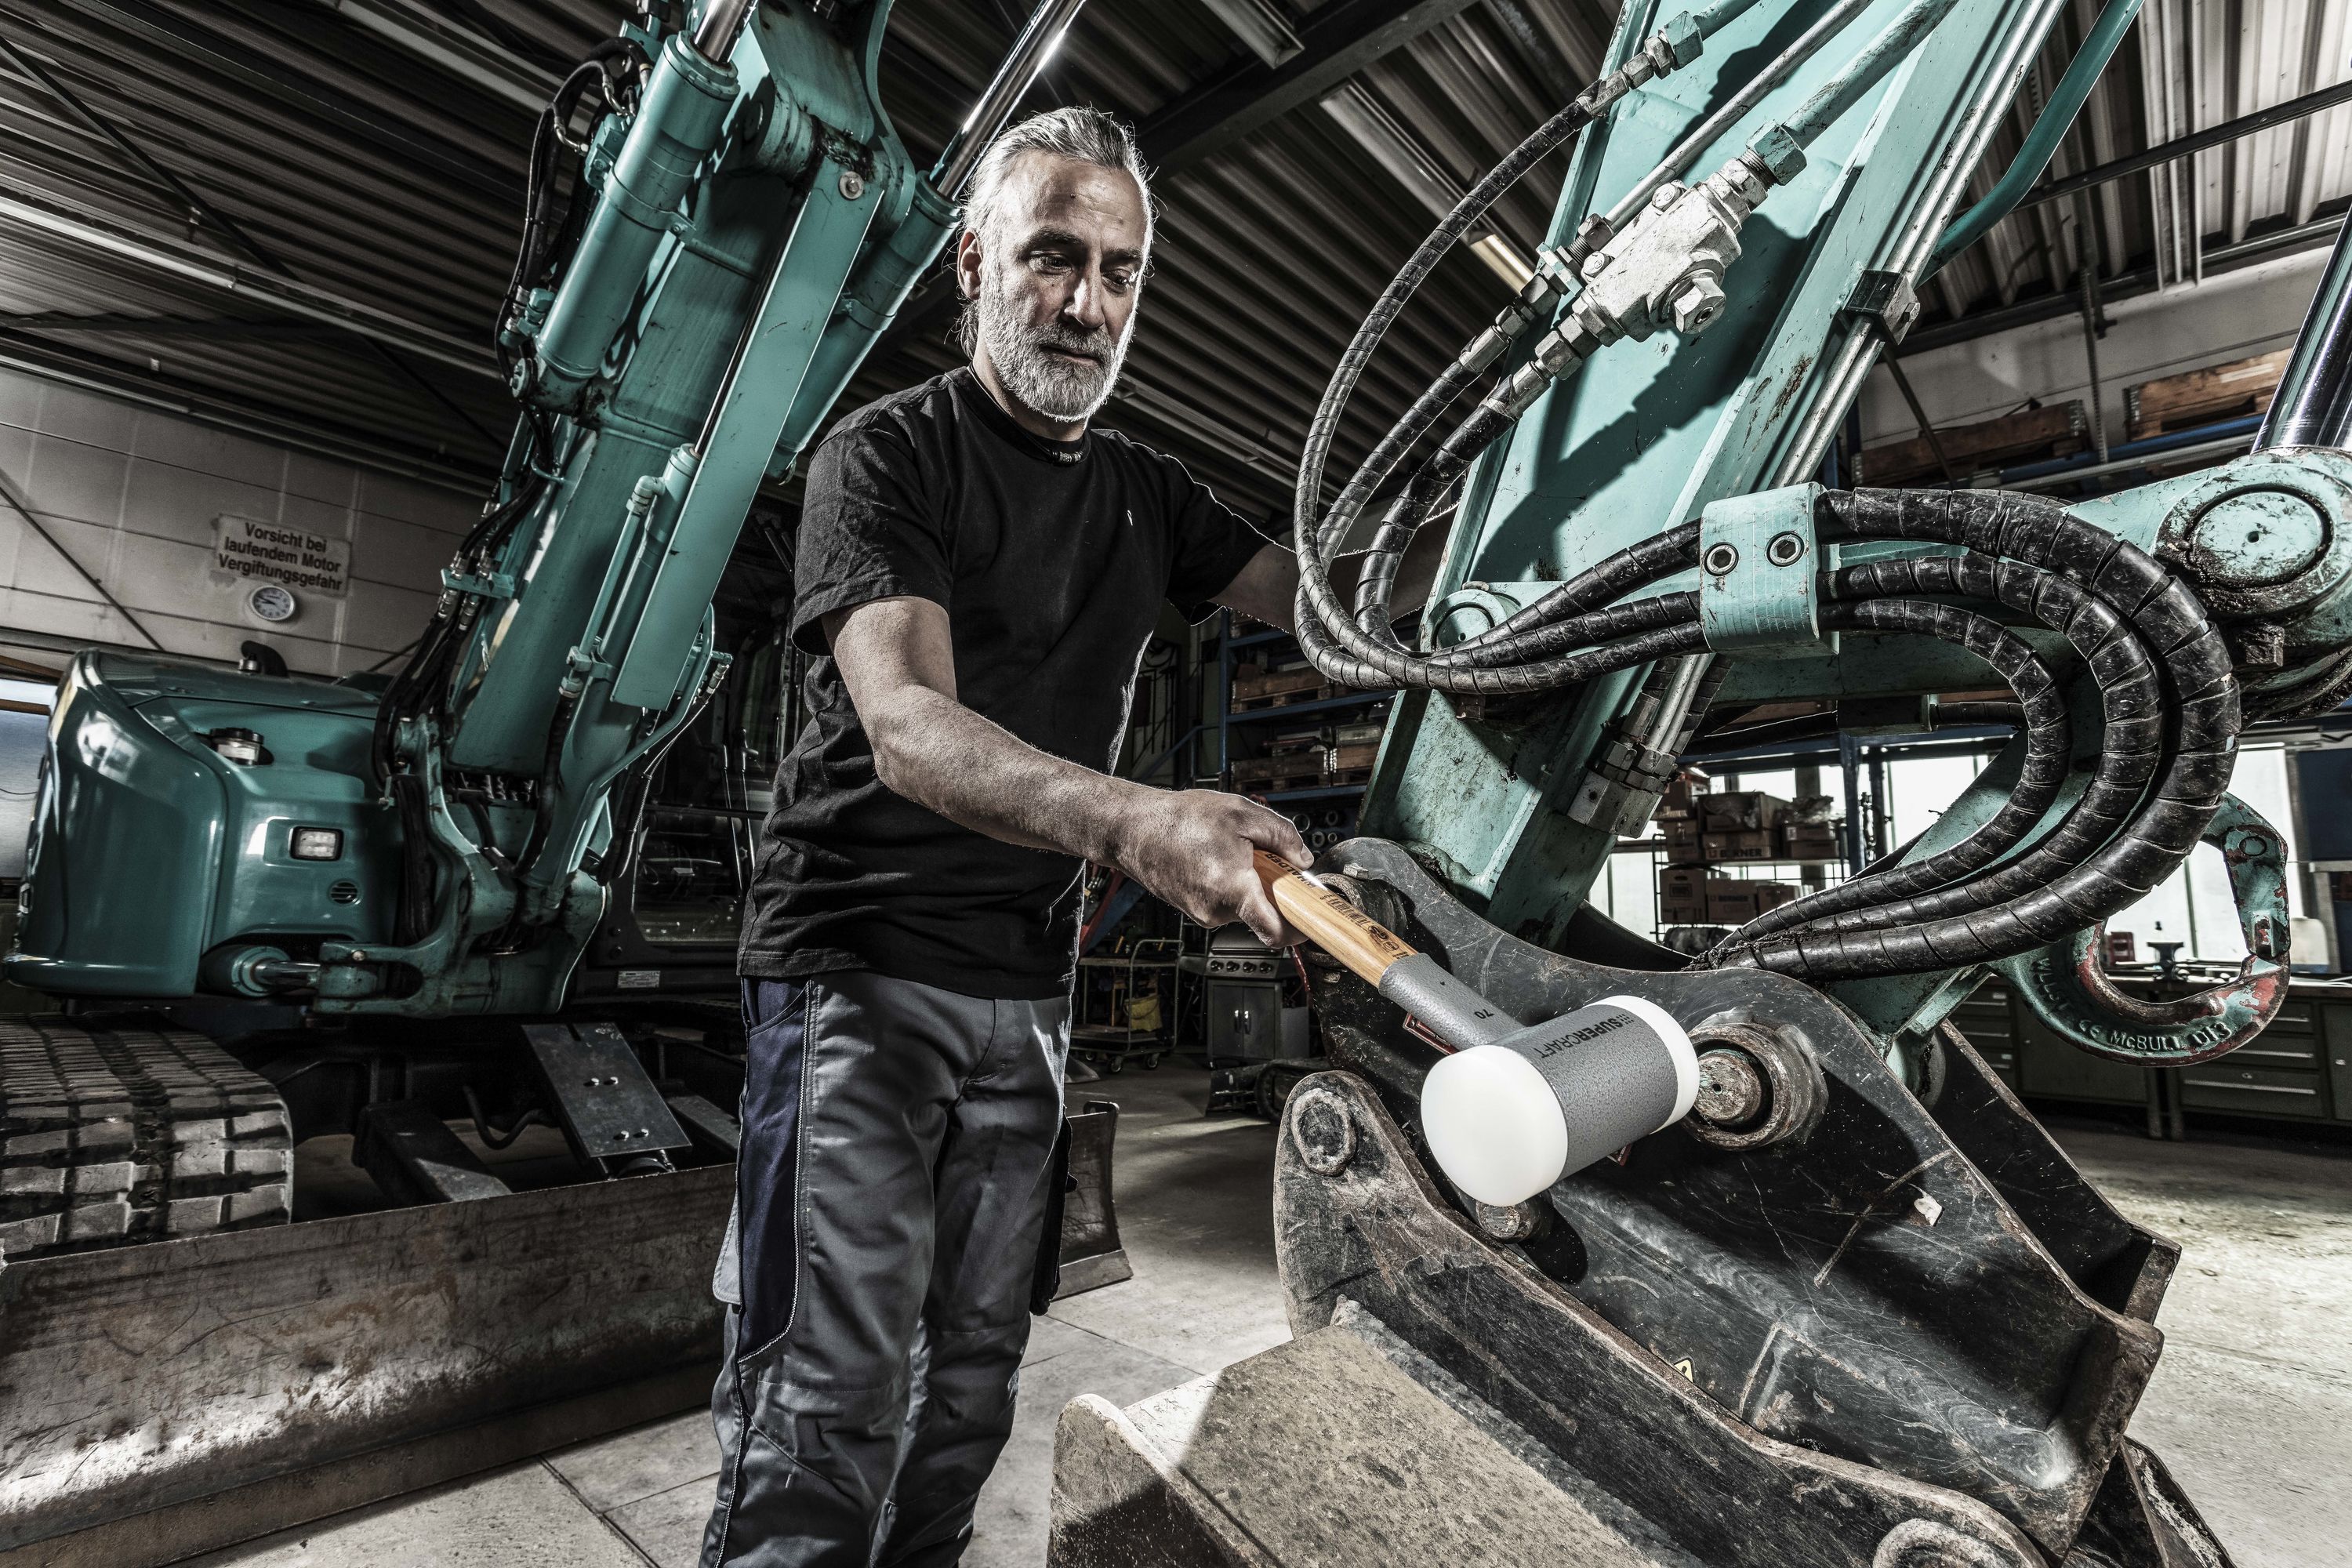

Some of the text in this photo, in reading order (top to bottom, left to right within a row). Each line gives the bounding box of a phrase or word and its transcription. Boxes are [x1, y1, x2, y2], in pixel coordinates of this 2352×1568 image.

[225, 536, 341, 572] laufendem Motor
[245, 522, 328, 553] Vorsicht bei
[218, 553, 343, 590] Vergiftungsgefahr
[1474, 1009, 1494, 1019] 70
[1534, 1018, 1624, 1058] SUPERCRAFT
